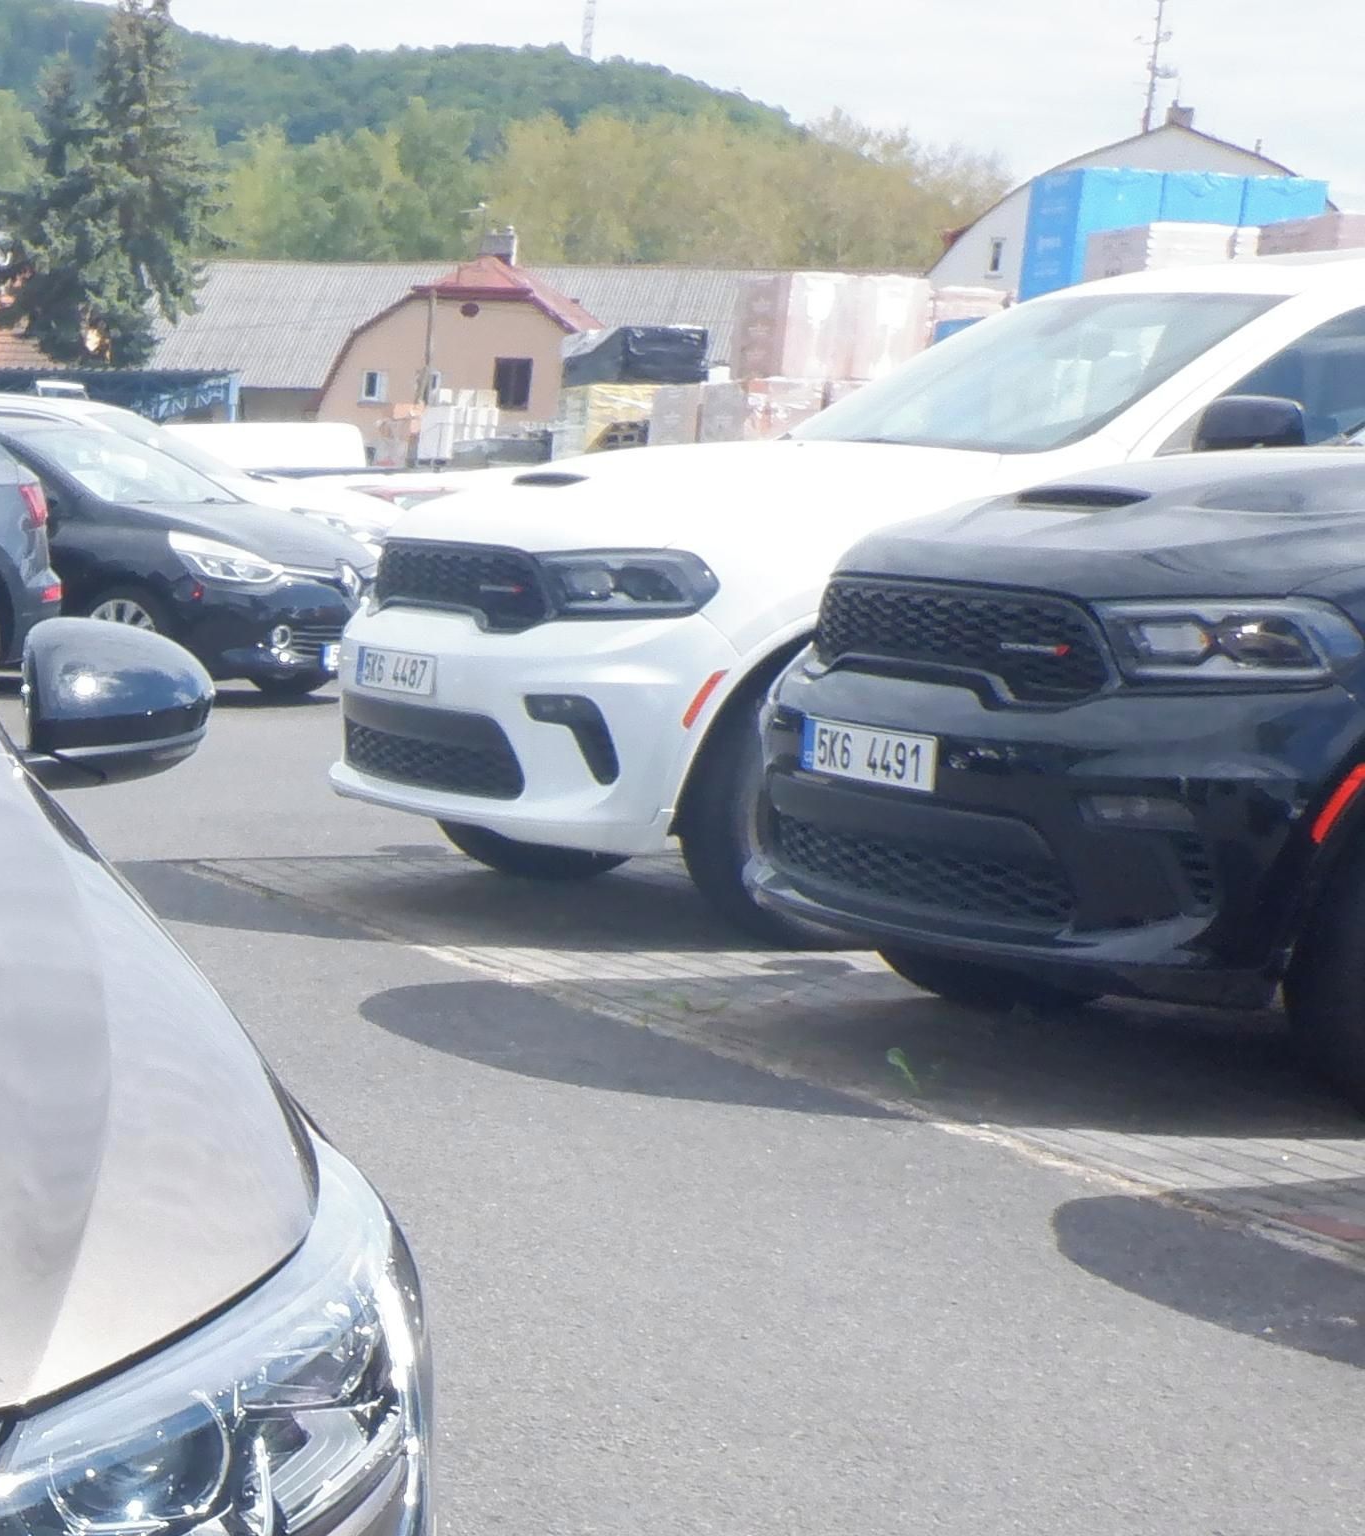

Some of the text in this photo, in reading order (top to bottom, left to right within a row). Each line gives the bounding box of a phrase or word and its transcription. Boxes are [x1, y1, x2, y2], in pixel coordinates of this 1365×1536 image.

[391, 656, 428, 689] 4487
[817, 728, 921, 782] 5K6 4491
